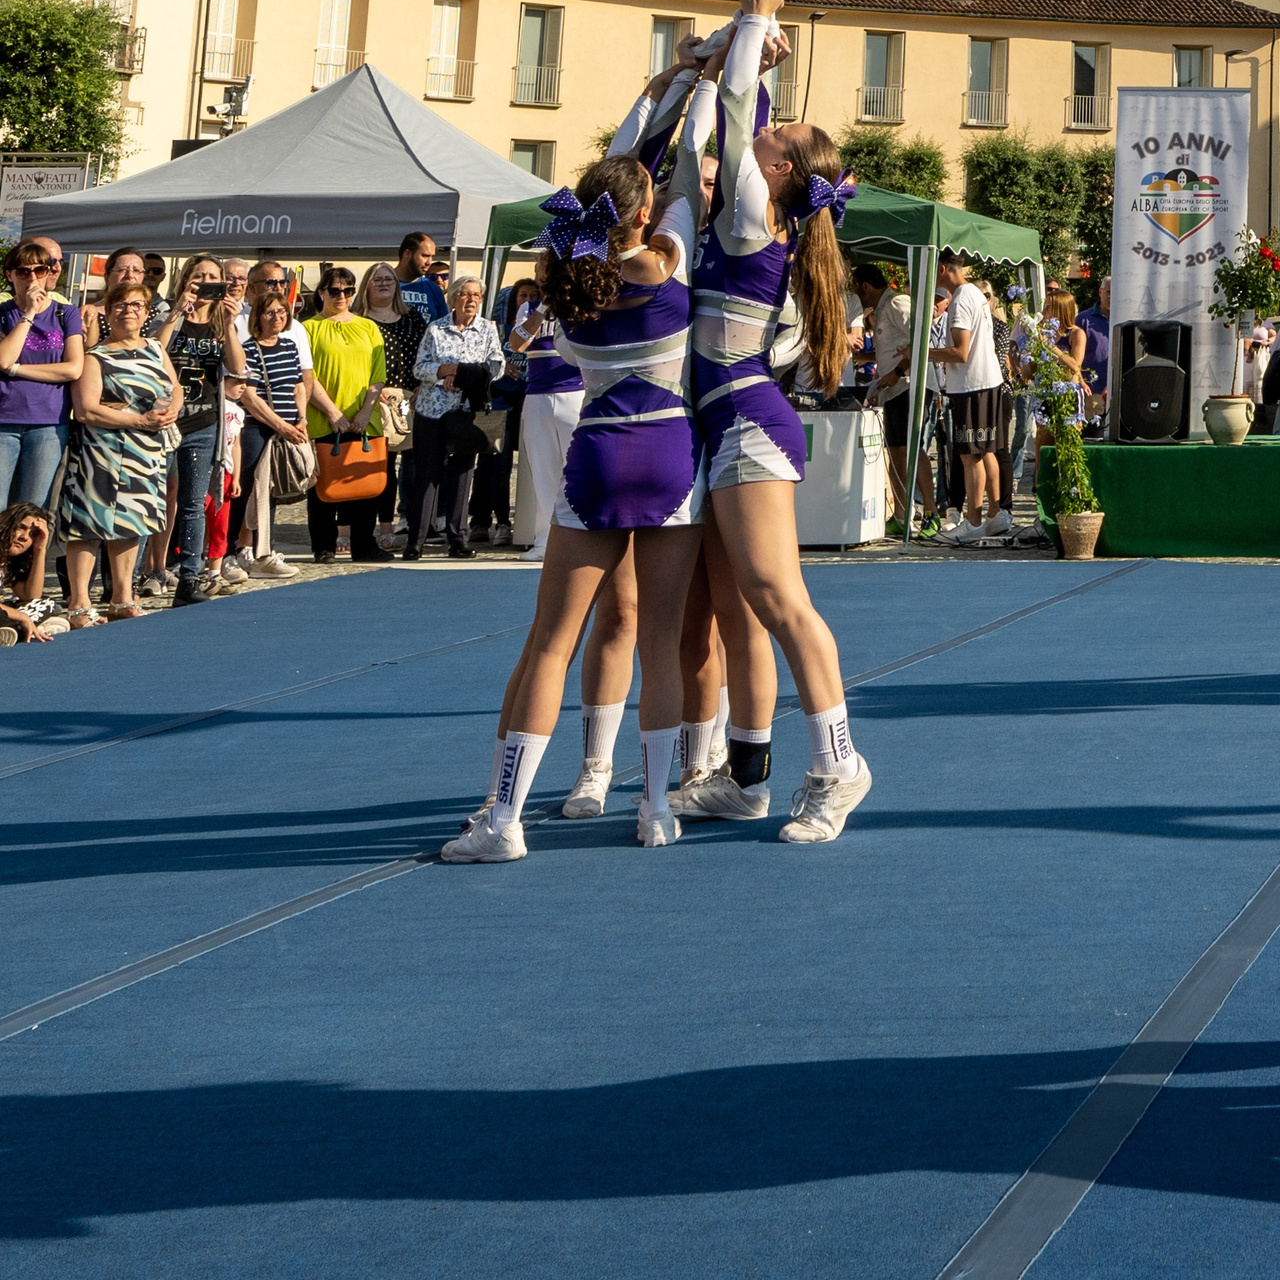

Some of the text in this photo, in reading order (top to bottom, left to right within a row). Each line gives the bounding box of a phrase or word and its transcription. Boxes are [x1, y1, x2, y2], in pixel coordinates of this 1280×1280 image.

[1131, 132, 1232, 161] 10 ANNI
[1176, 154, 1190, 166] di
[1131, 199, 1159, 212] ALBA
[181, 209, 291, 235] fielmann
[1132, 241, 1170, 266] 2013
[1185, 241, 1226, 268] 2023
[402, 291, 428, 303] LTRE
[499, 744, 518, 804] TITANS
